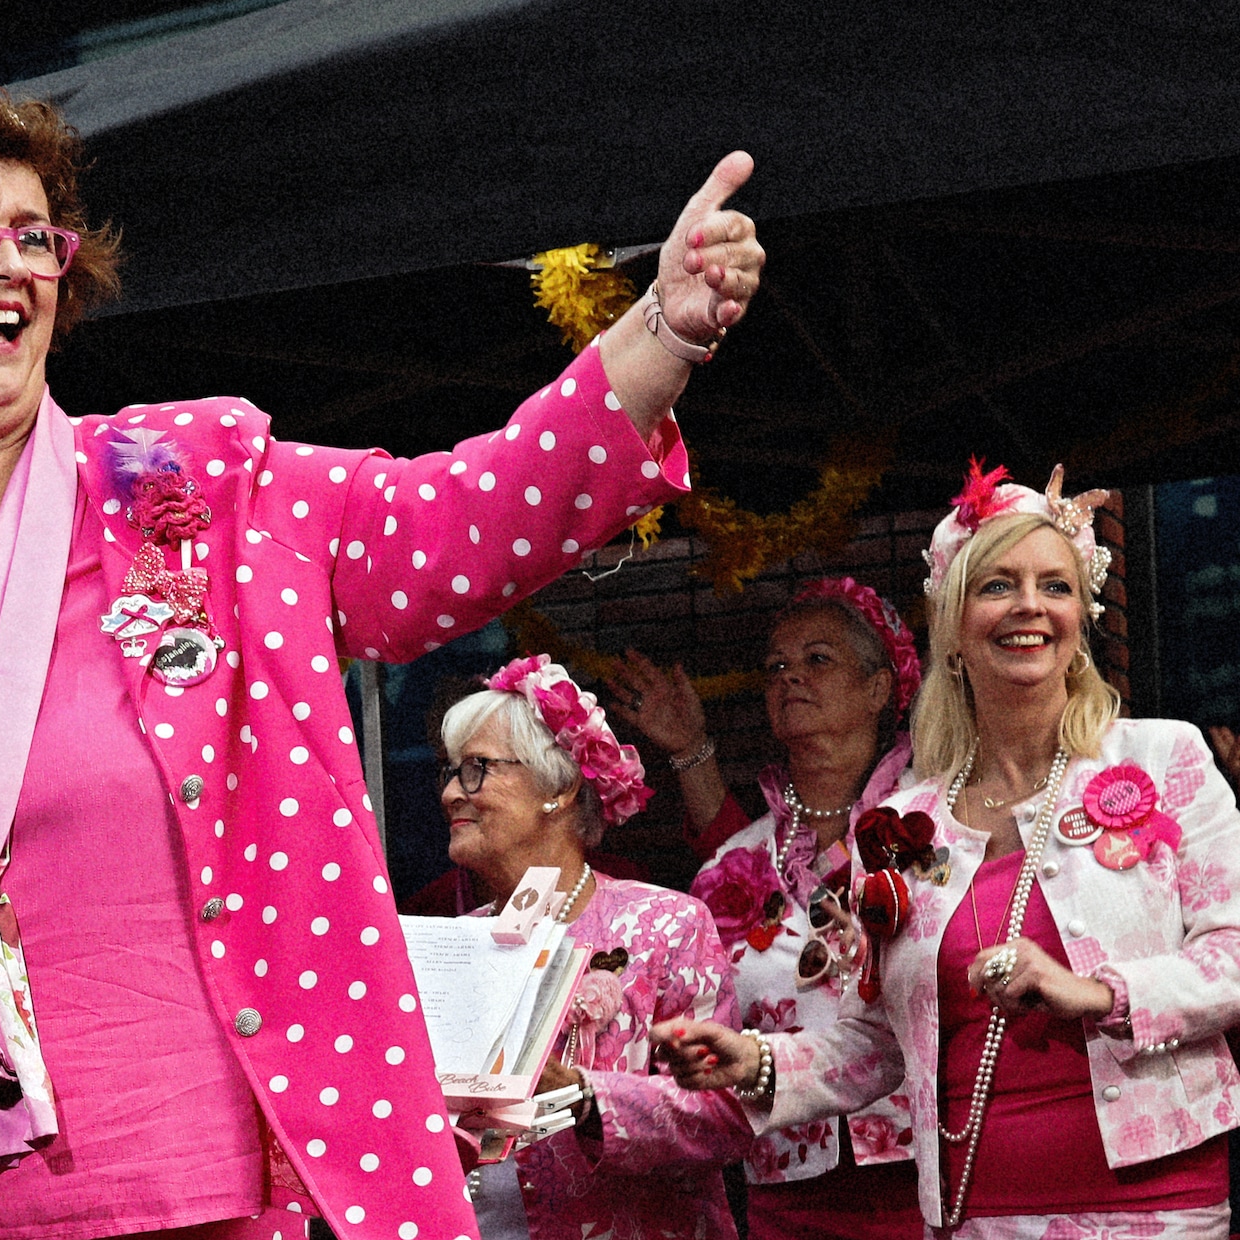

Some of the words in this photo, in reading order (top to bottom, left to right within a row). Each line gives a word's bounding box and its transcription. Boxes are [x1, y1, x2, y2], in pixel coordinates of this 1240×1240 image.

[1063, 811, 1087, 824] GIRL
[1072, 819, 1087, 828] ON
[1068, 825, 1094, 837] TOUR
